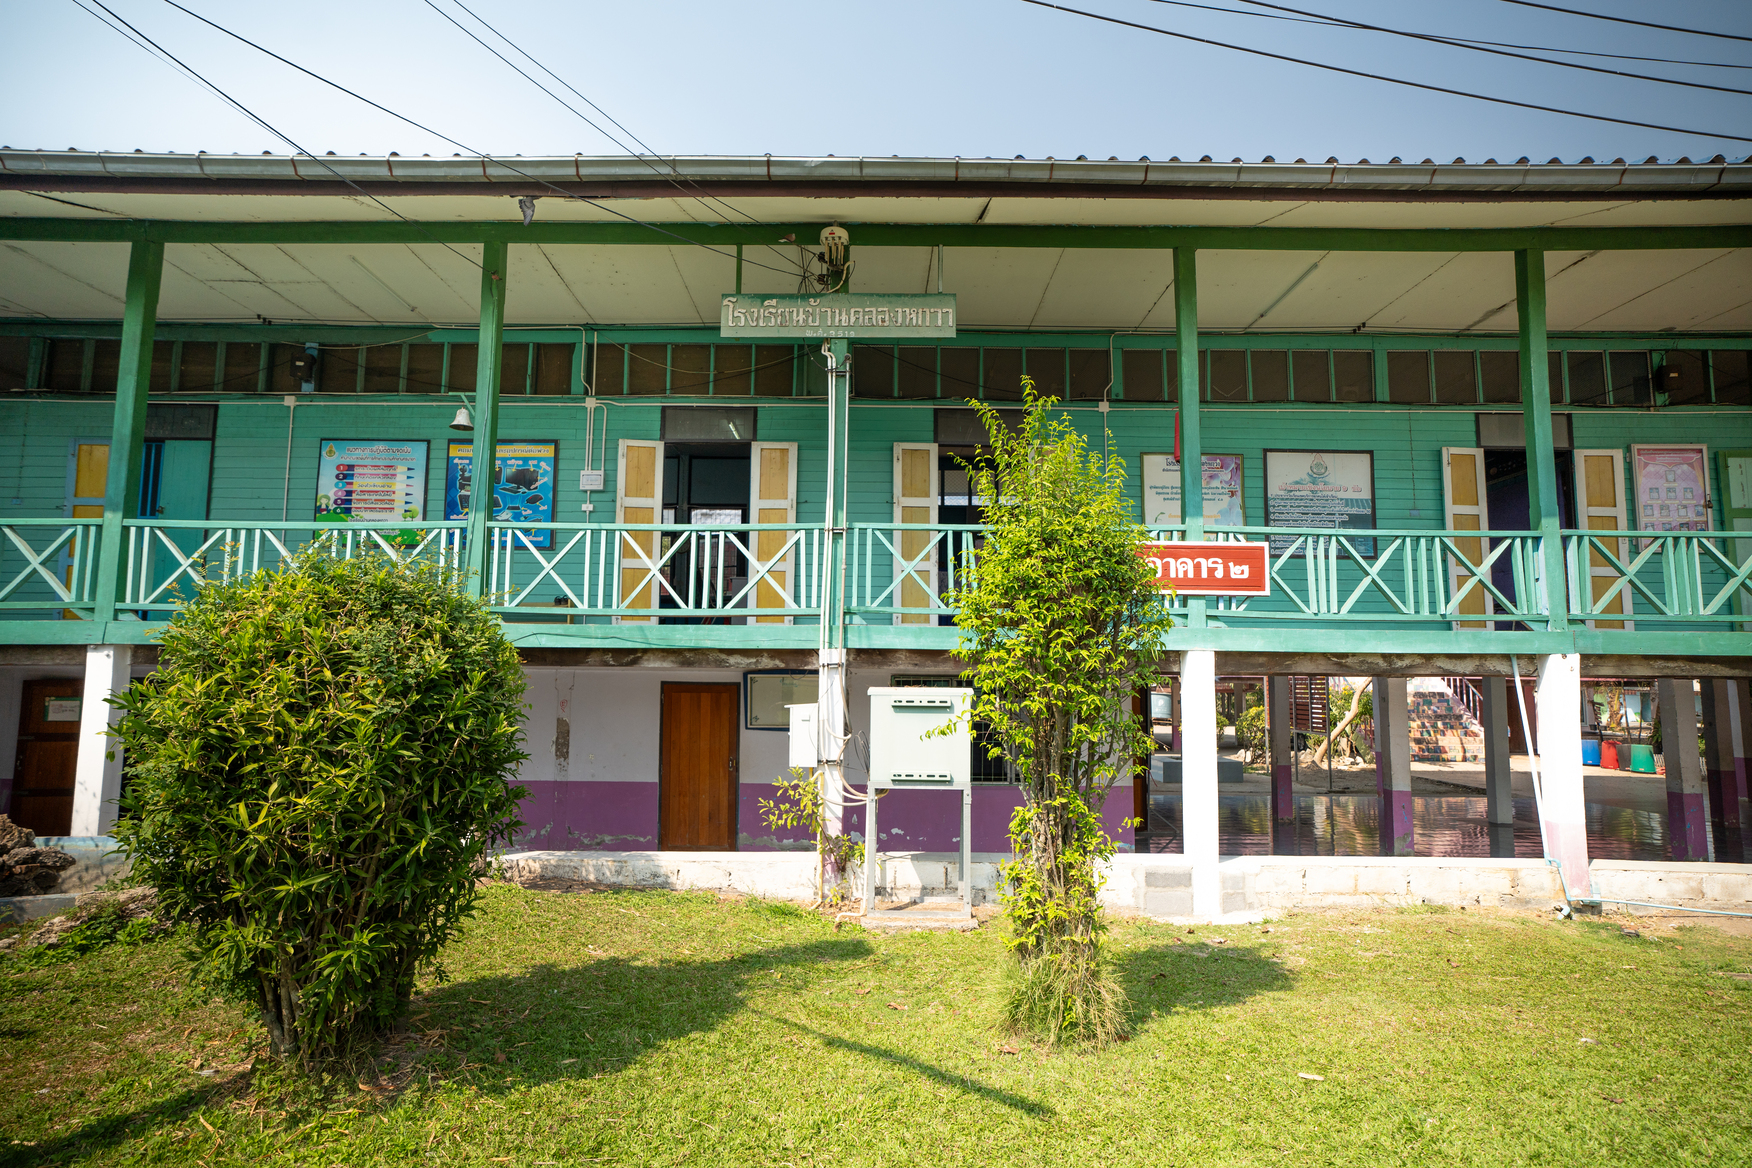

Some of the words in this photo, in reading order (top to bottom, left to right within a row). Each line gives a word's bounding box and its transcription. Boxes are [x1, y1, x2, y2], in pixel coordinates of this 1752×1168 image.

[722, 297, 954, 327] โรงเรียนบ้านคลองหกวา
[1145, 557, 1224, 579] อาคาร
[1228, 561, 1250, 579] ๒
